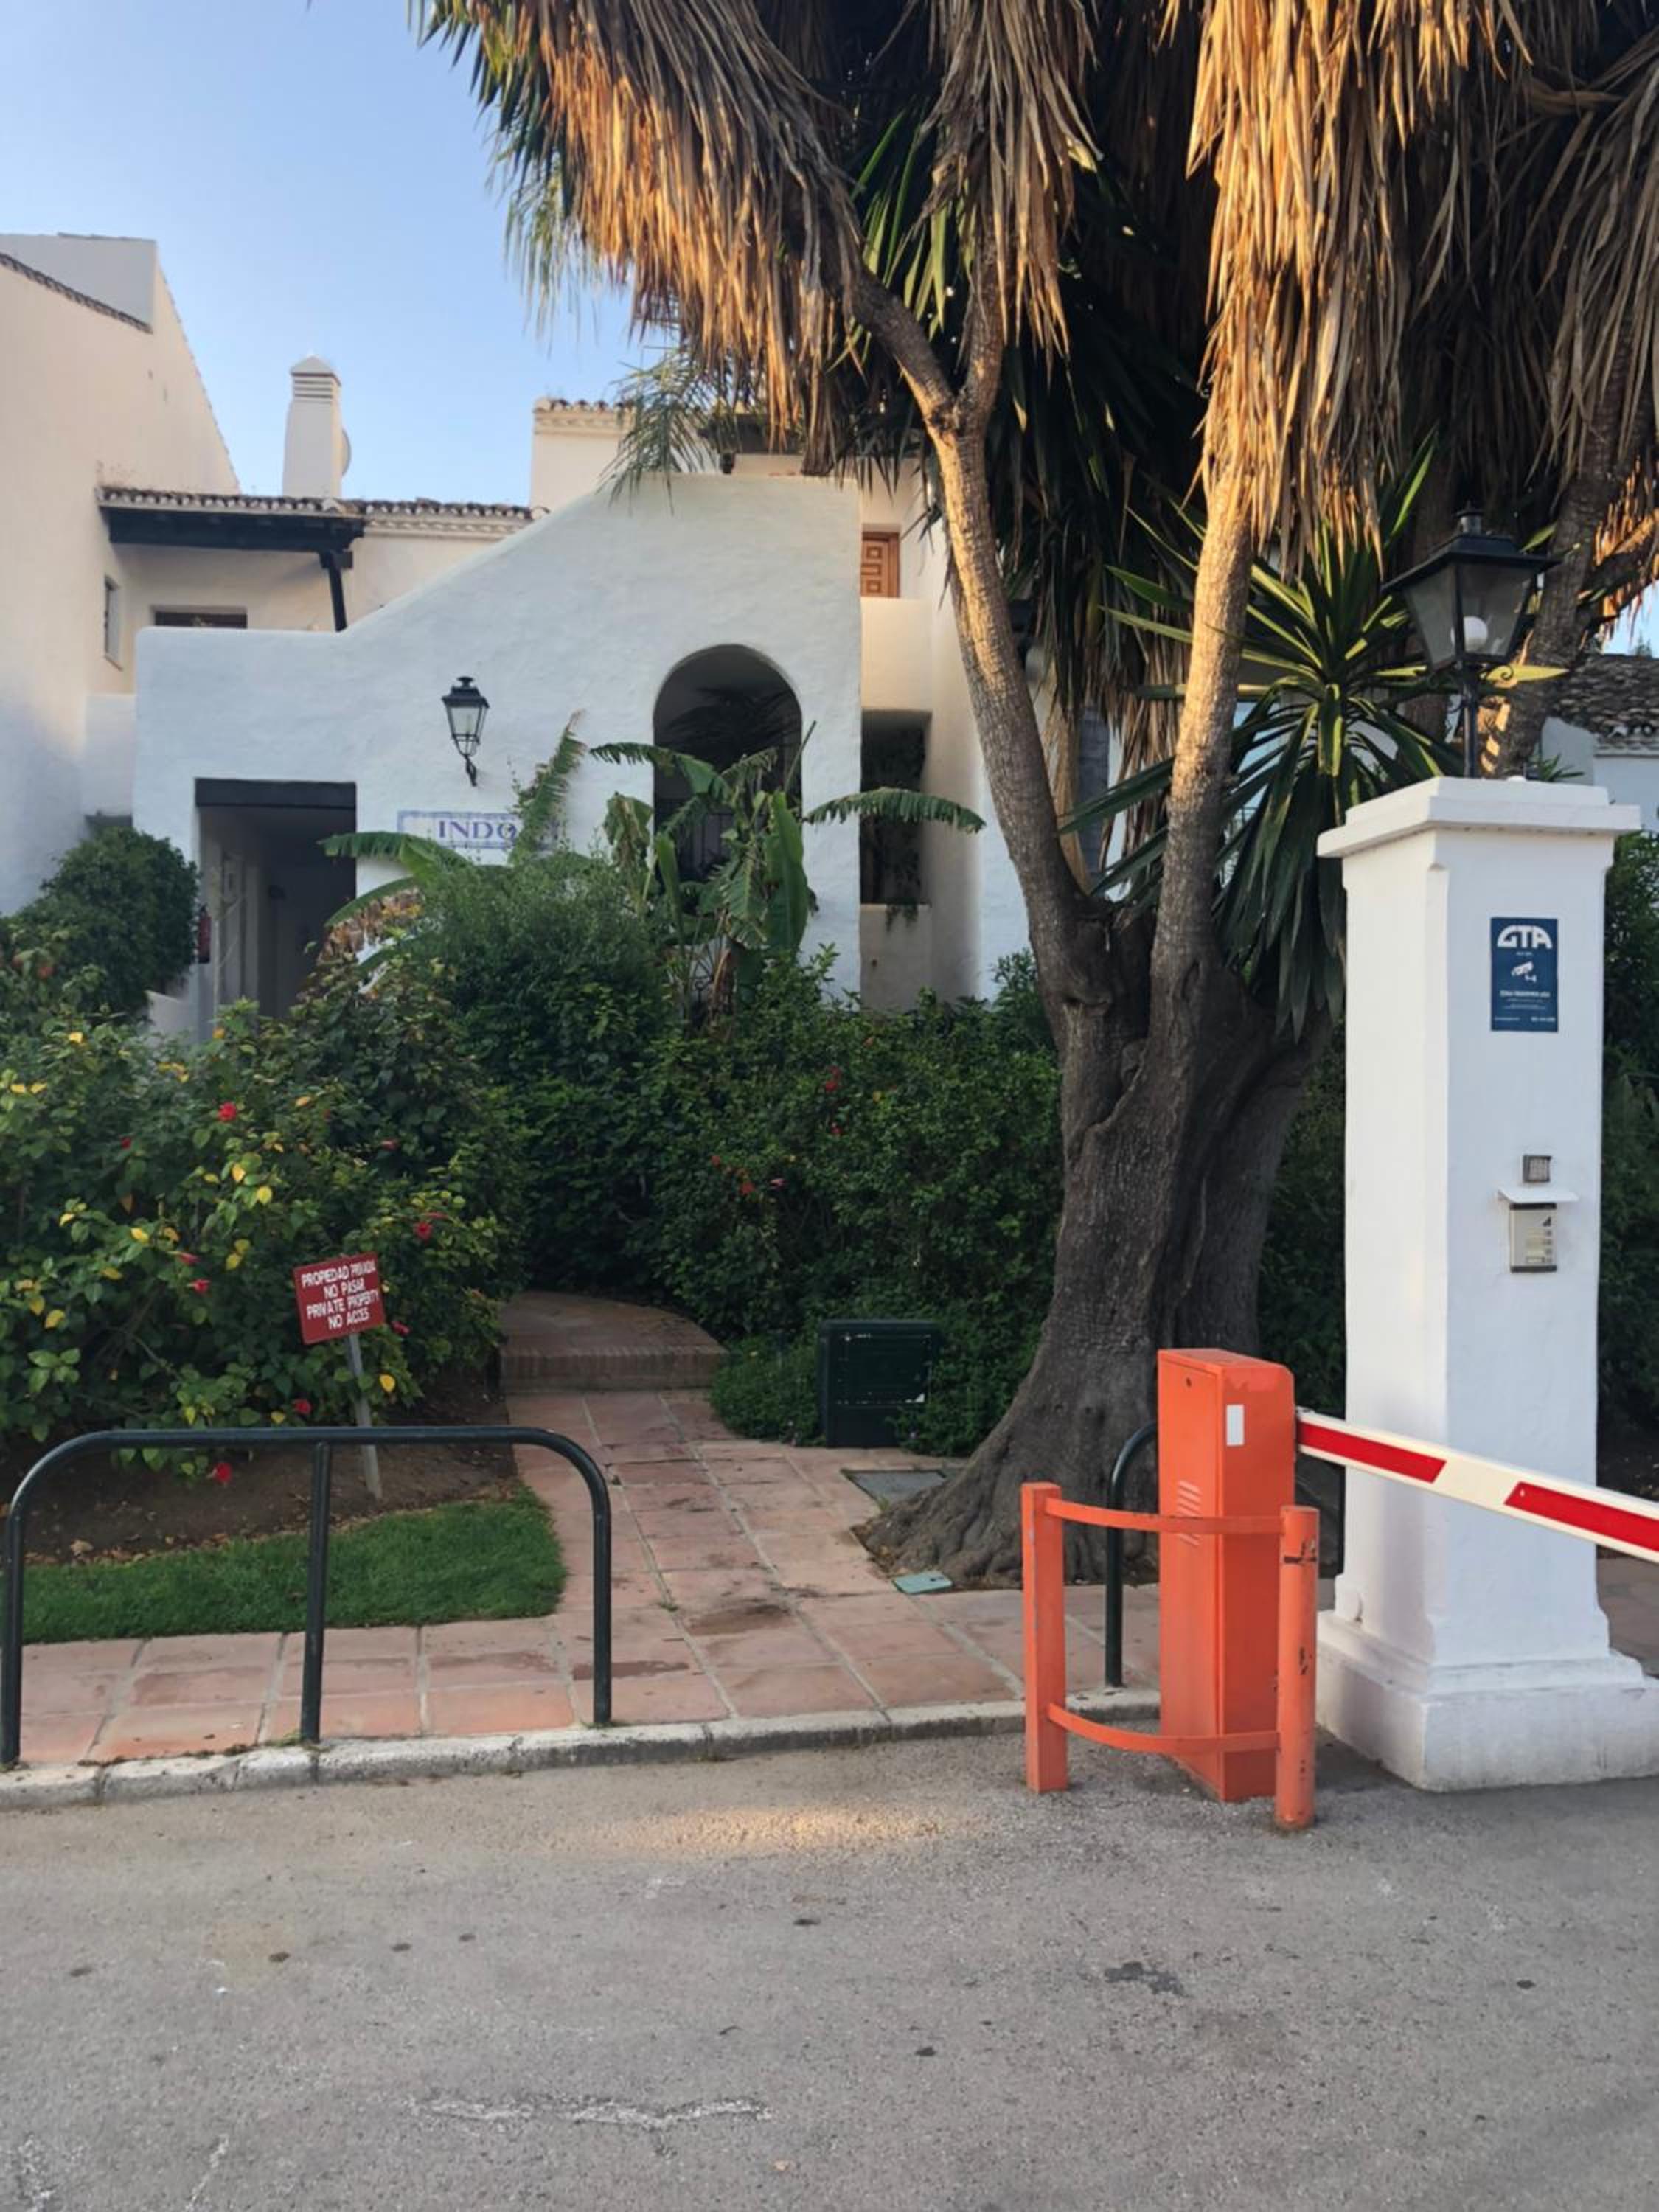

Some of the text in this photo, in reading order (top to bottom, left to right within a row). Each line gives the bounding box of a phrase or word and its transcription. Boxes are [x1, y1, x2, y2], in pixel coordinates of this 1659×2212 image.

[1497, 925, 1553, 949] GTA
[323, 1284, 338, 1299] NO
[306, 1298, 346, 1319] PRIVATE
[327, 1314, 343, 1330] NO
